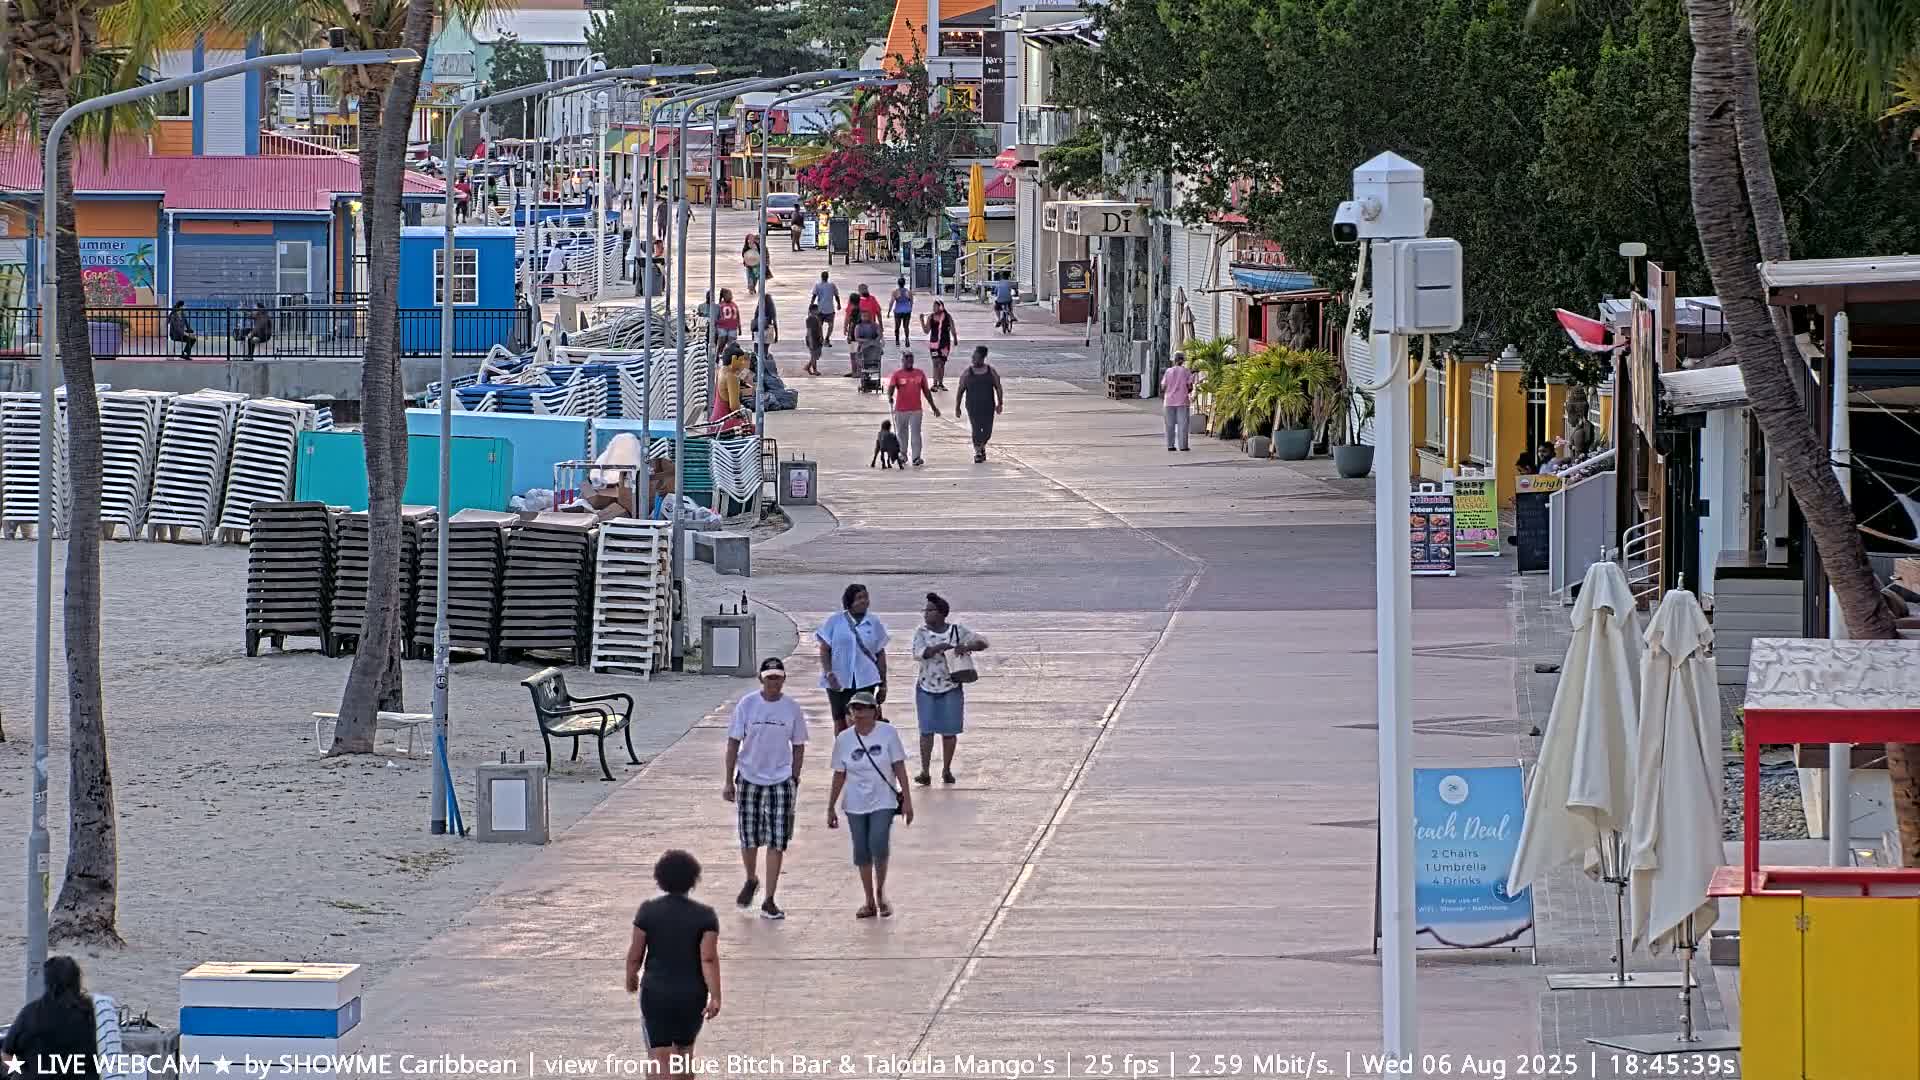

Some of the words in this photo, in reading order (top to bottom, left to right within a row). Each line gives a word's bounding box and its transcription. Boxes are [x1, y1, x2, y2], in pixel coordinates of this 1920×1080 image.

[79, 241, 126, 250] ummer
[80, 255, 125, 265] ADNESS
[1455, 481, 1485, 489] Susy
[1412, 810, 1457, 840] each
[1463, 813, 1510, 840] Deal
[1431, 849, 1439, 858] 2
[1442, 849, 1479, 858] Chairs
[1425, 864, 1429, 872] 1
[1433, 863, 1486, 872] Umbrella
[1443, 876, 1480, 885] Drinks
[1441, 896, 1456, 904] Free
